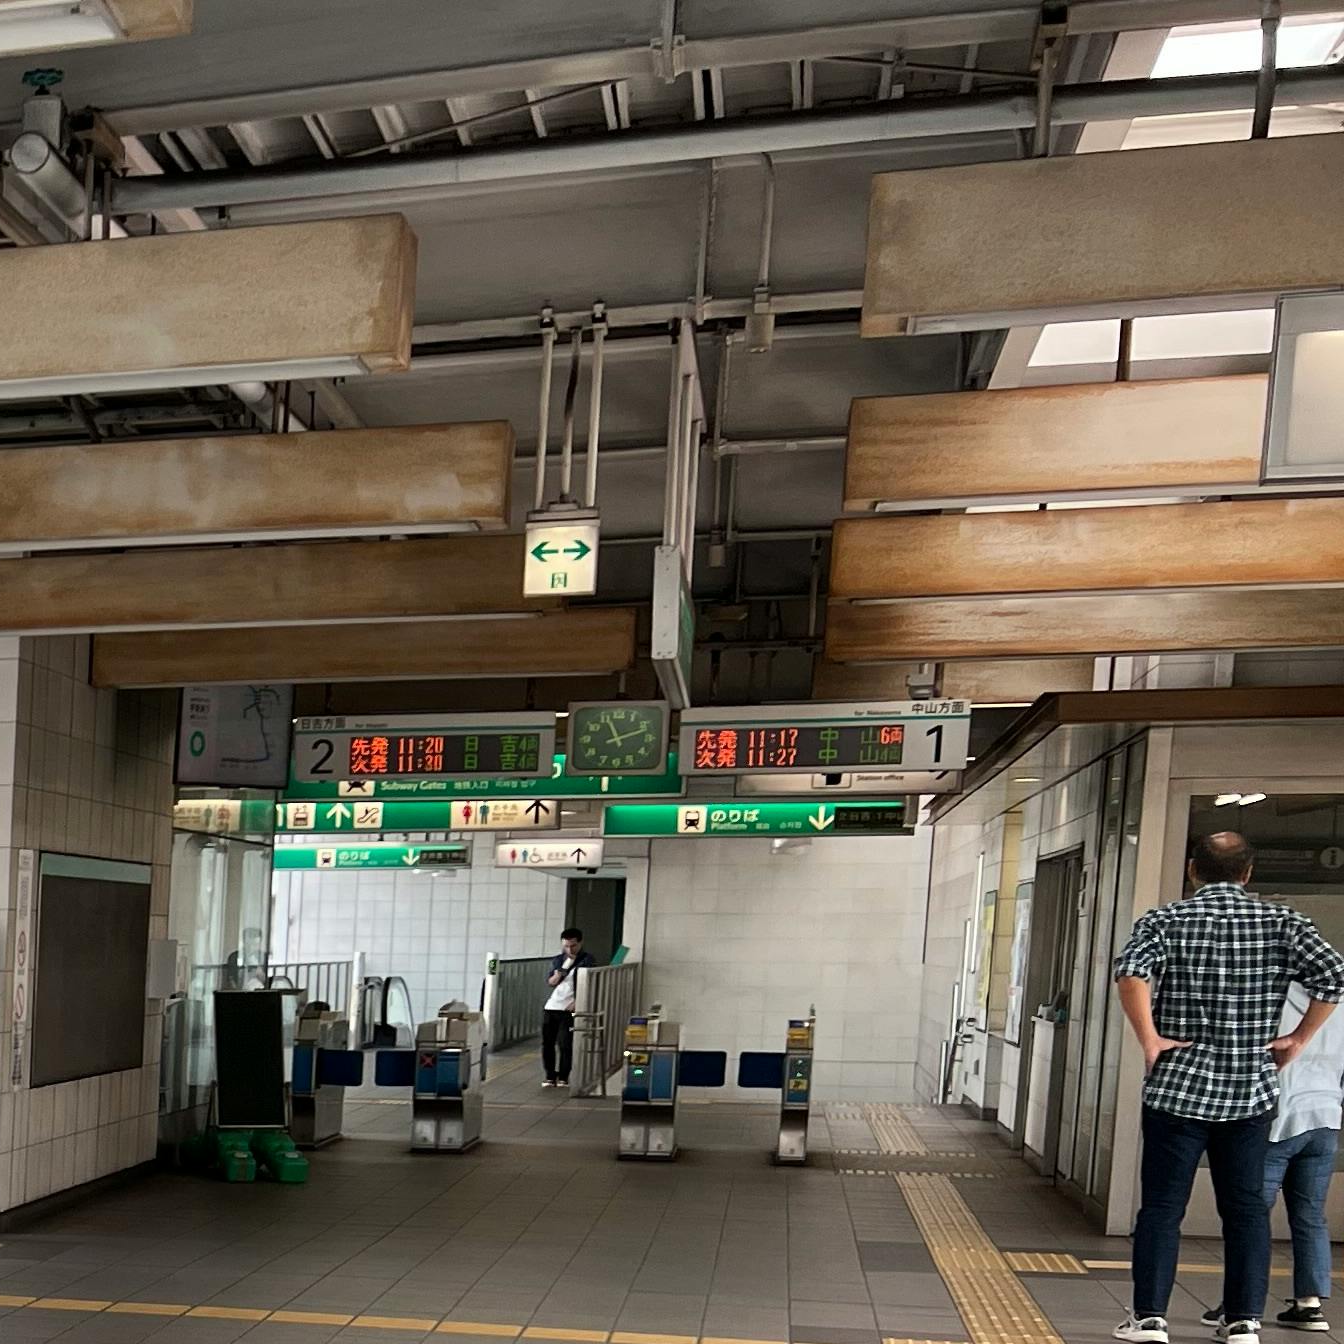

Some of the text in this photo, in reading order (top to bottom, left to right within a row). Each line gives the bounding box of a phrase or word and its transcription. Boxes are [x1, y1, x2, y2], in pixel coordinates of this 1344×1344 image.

[912, 701, 964, 714] 中山方面
[301, 717, 346, 729] 日吉方面
[351, 736, 388, 755] 先発
[397, 736, 444, 755] 11:20
[697, 730, 738, 749] 先発
[749, 729, 798, 747] 11:17
[925, 724, 943, 763] 1
[310, 738, 334, 774] 2
[351, 755, 388, 773] 次発
[397, 754, 443, 772] 11:30
[696, 749, 737, 768] 次発
[747, 748, 797, 767] 11:27
[380, 780, 447, 792] Subway Gates
[711, 808, 760, 823] のりば
[711, 823, 748, 831] Platform
[339, 850, 371, 860] のりば
